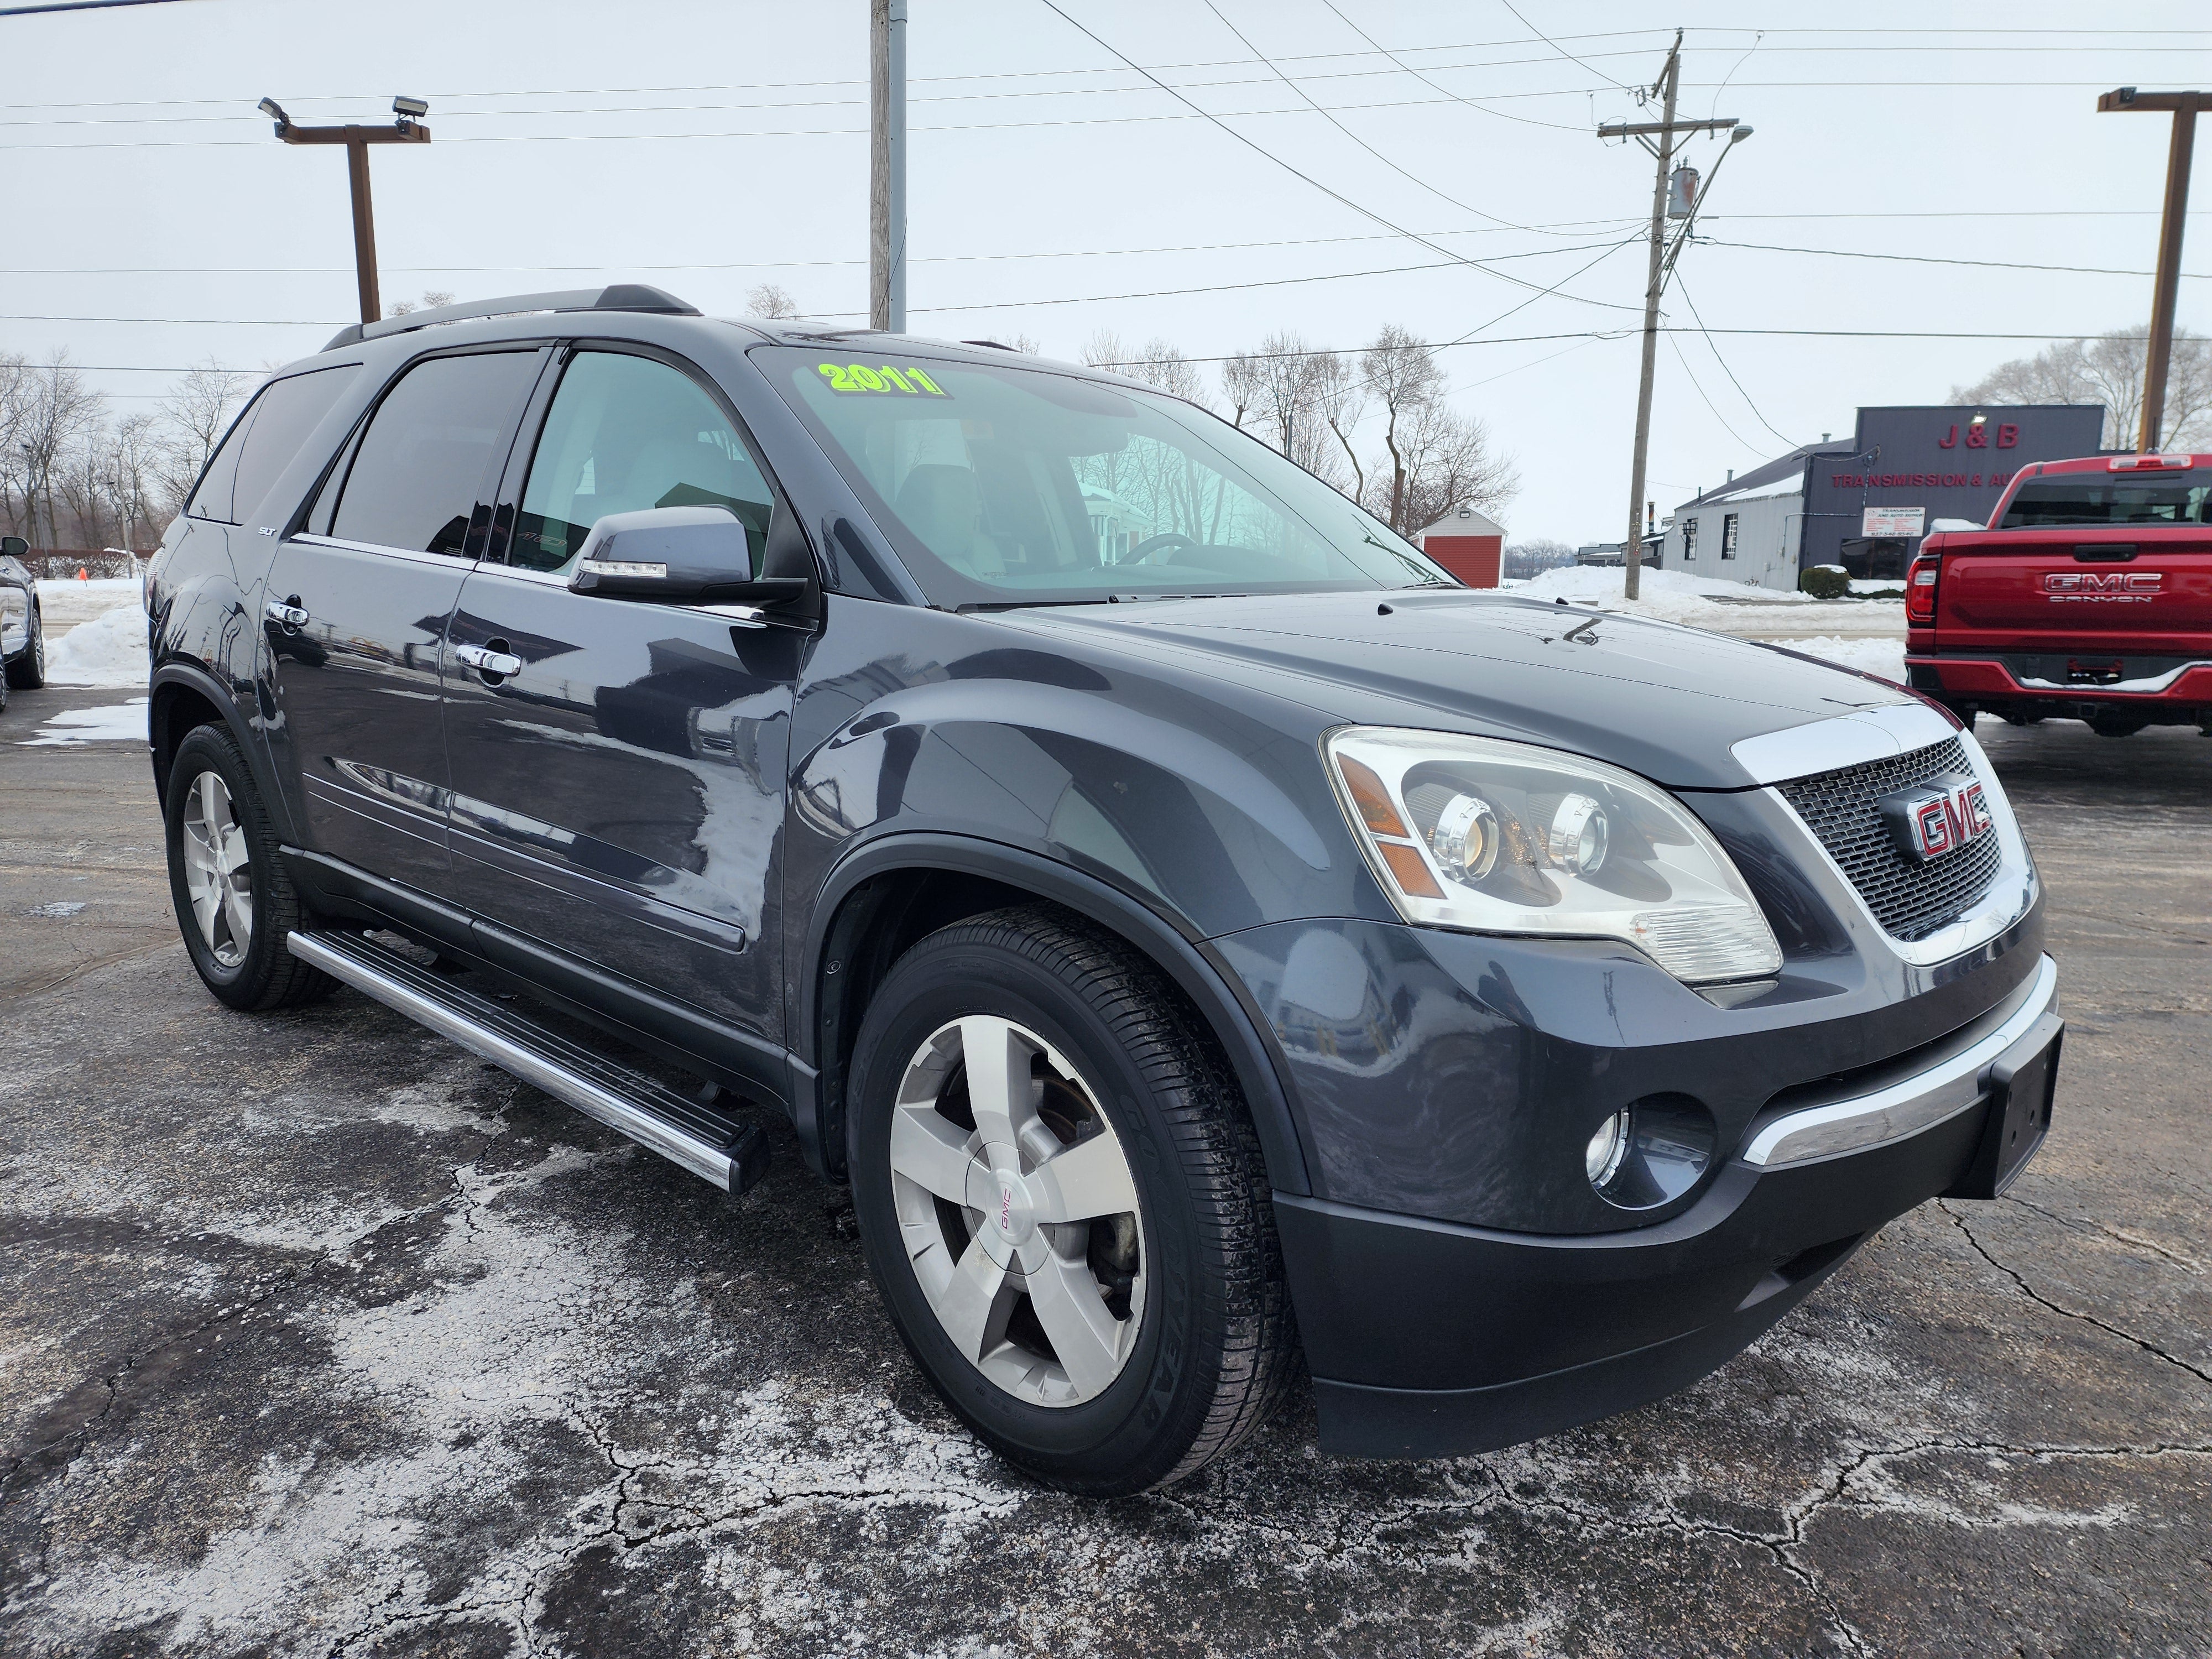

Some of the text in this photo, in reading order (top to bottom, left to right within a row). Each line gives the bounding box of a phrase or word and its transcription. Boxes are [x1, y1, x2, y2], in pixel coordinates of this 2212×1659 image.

[818, 363, 947, 396] 2011
[1938, 423, 2020, 449] J & B
[1832, 473, 1967, 487] TRANSMISSION
[1970, 473, 1983, 487] &
[258, 526, 277, 536] SLT
[2045, 573, 2163, 592] GMC
[1907, 777, 1991, 862] GMC
[1001, 1187, 1011, 1229] GMC
